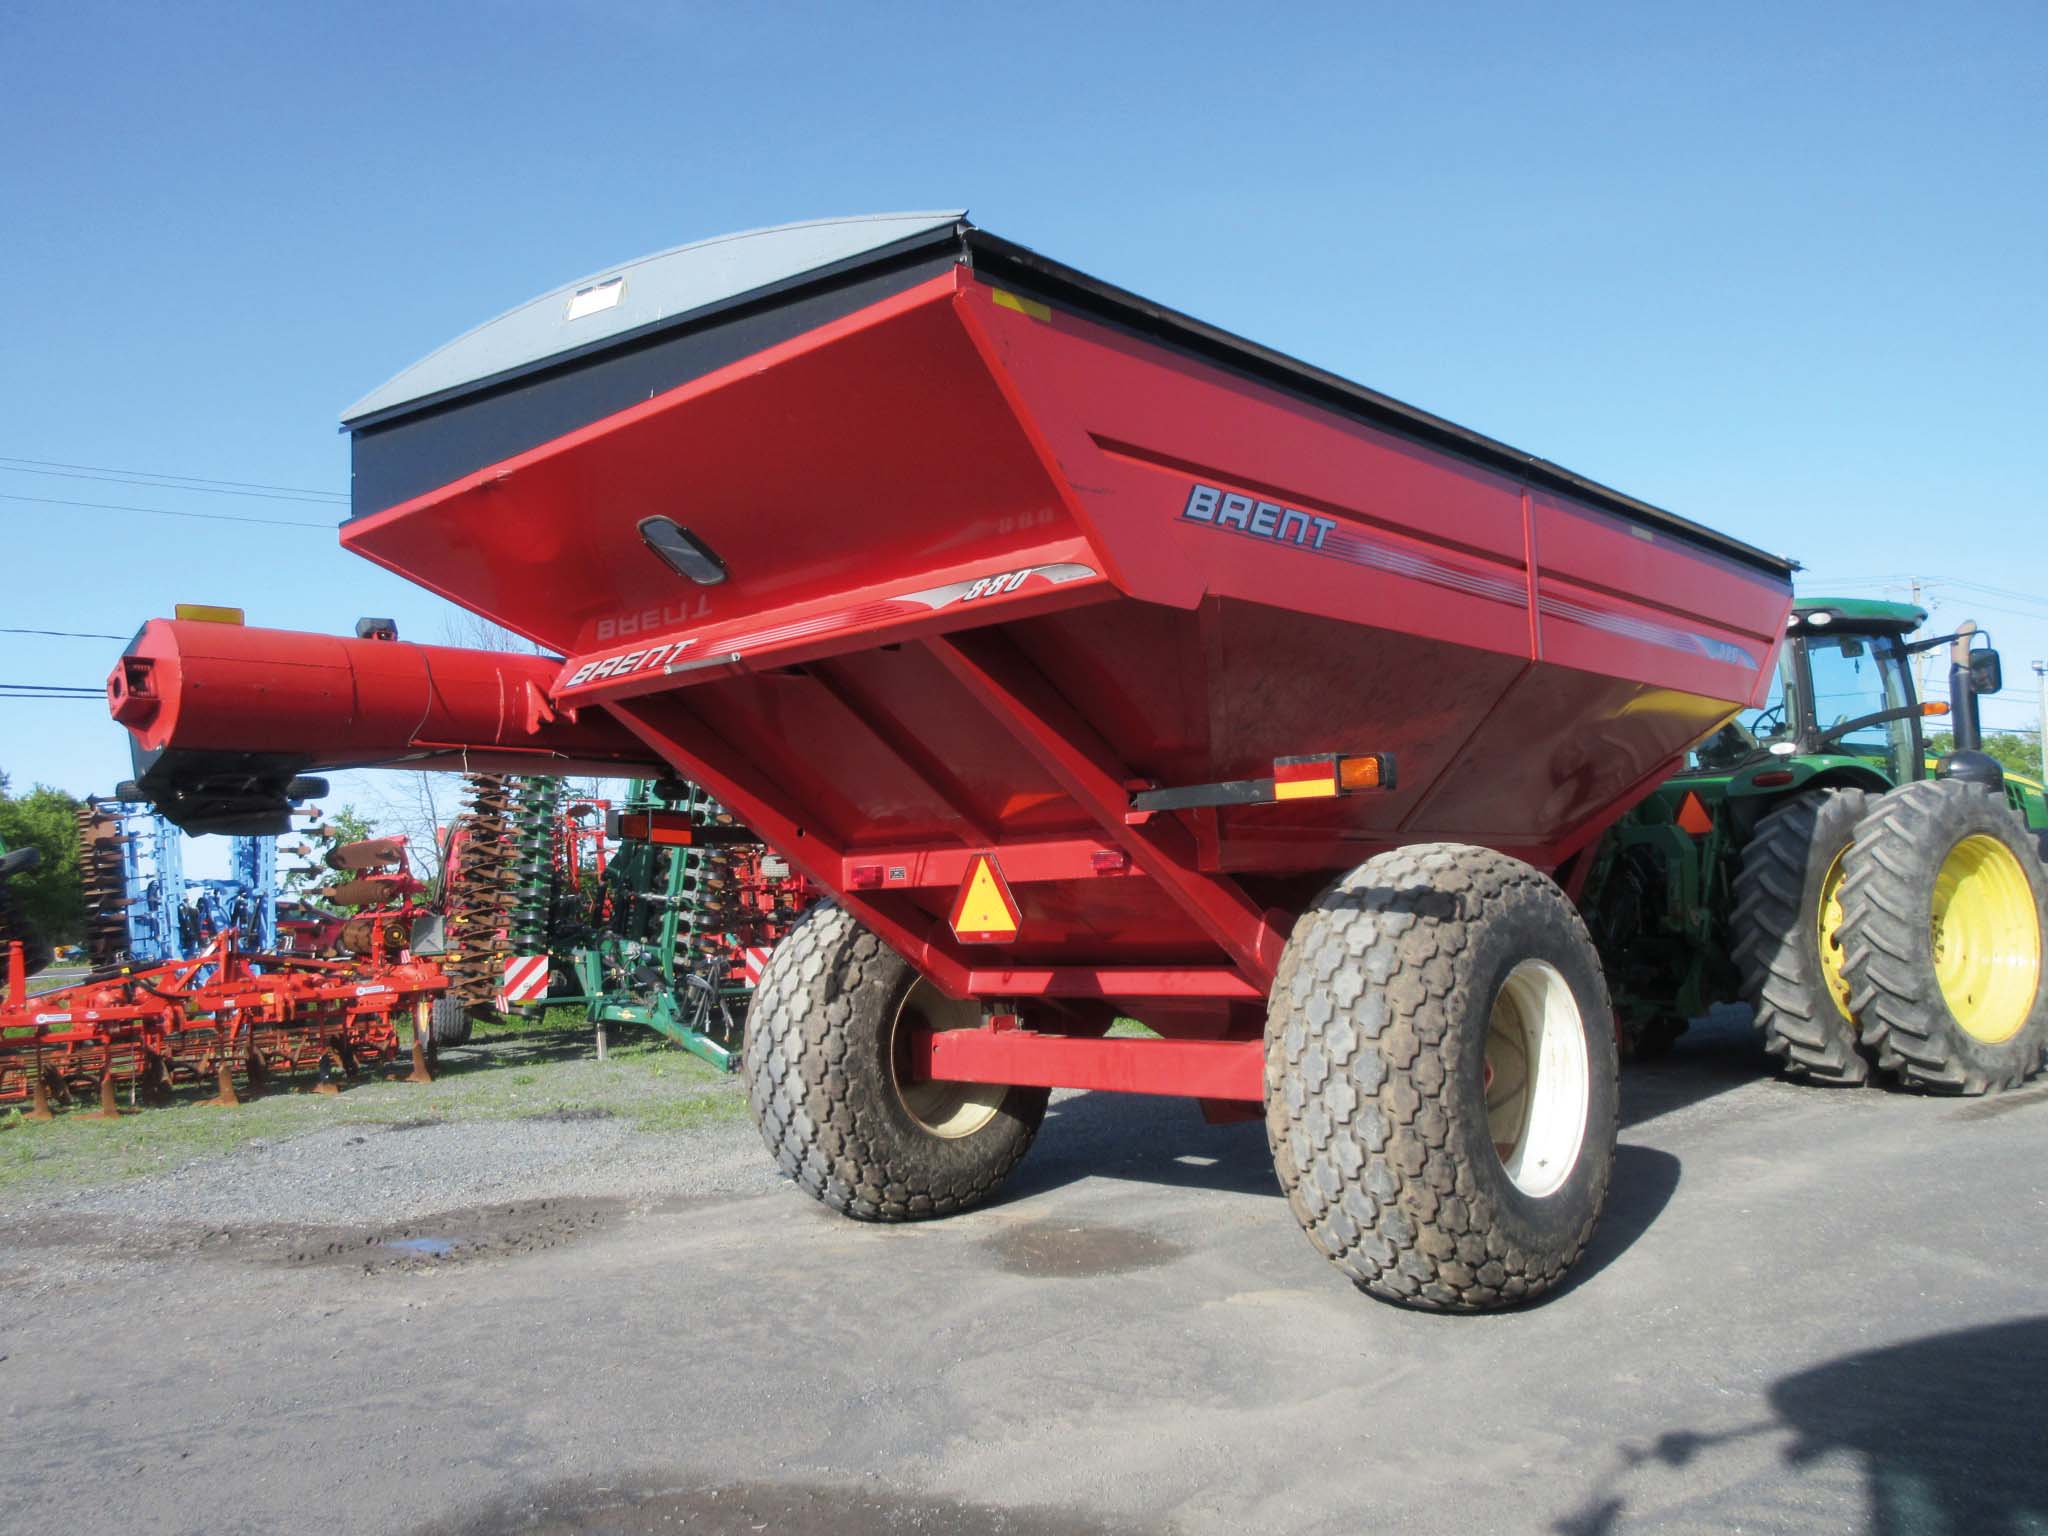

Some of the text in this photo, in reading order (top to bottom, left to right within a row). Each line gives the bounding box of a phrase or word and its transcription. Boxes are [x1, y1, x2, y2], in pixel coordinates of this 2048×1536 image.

[1184, 483, 1337, 549] BRENT
[961, 568, 1033, 601] 880
[564, 637, 699, 688] BRENT
